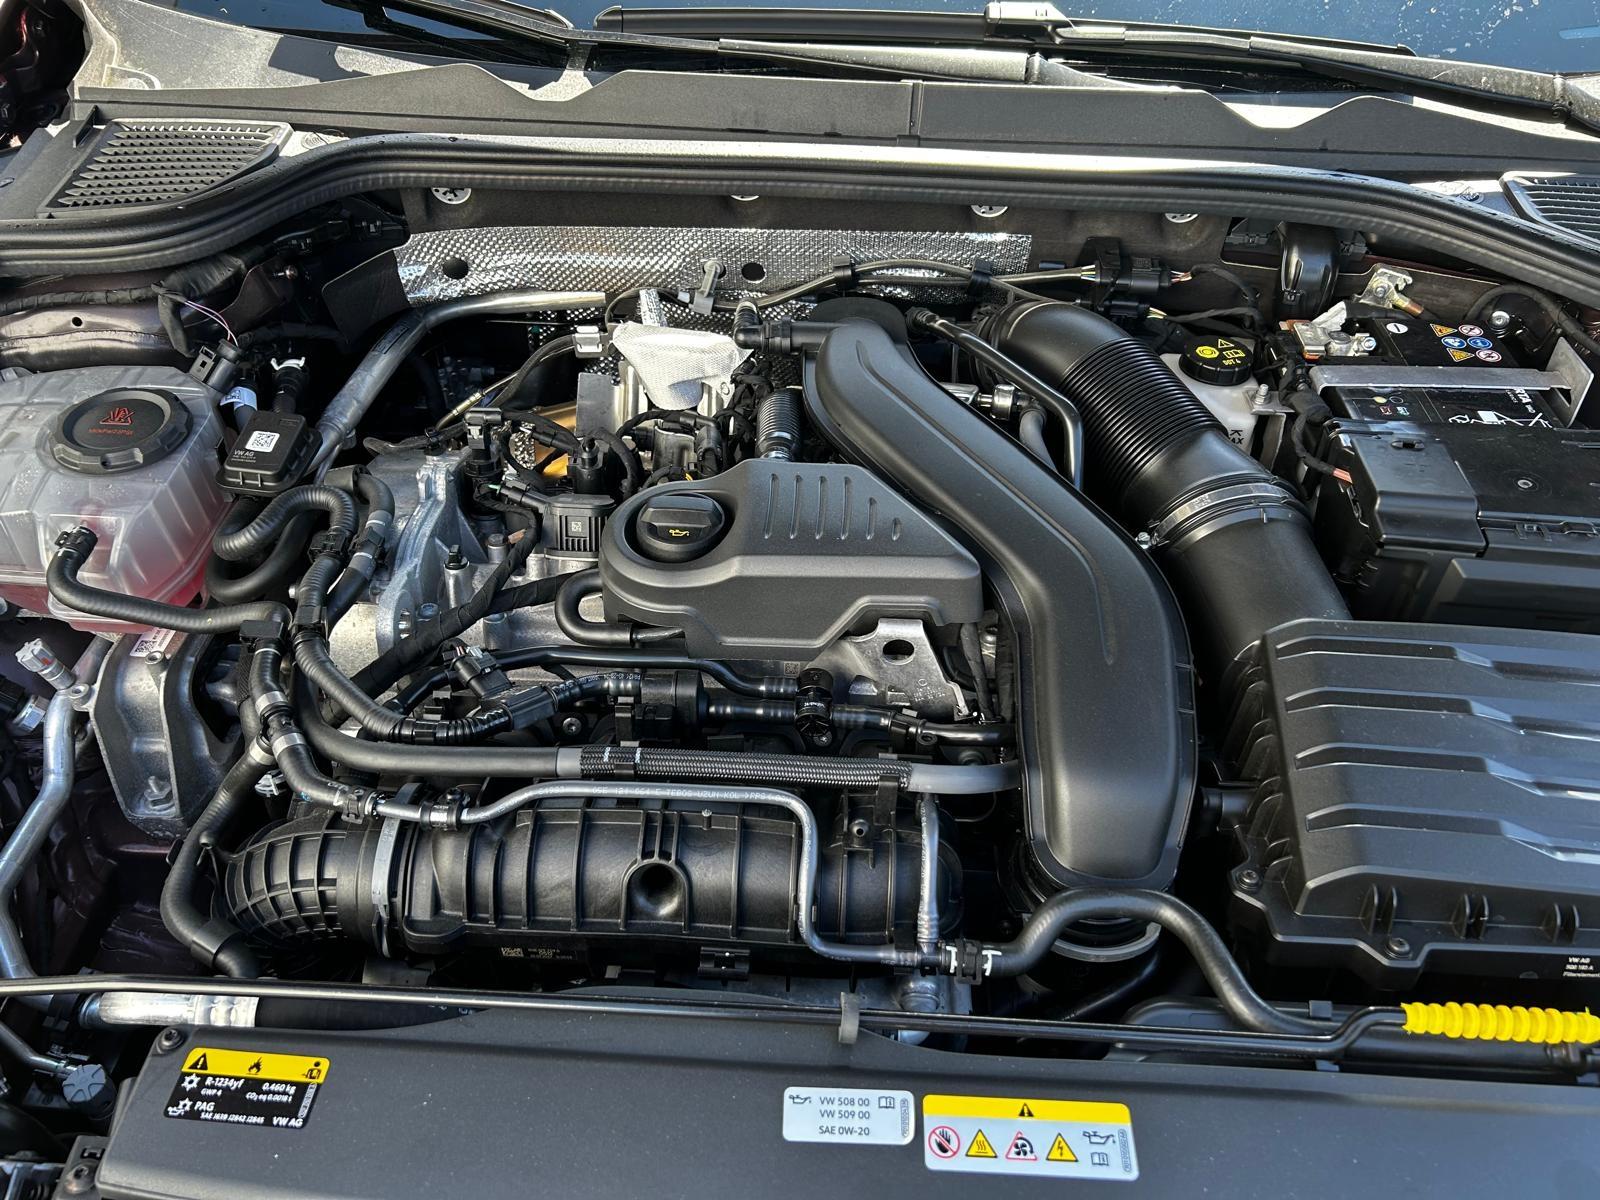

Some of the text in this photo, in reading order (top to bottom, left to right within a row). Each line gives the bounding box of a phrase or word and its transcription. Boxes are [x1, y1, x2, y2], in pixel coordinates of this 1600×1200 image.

[204, 1076, 297, 1095] R-1234yf 0.460 kg
[200, 1088, 217, 1096] GWP
[819, 1097, 870, 1106] VW 508 00
[194, 1102, 215, 1111] PAG
[819, 1110, 870, 1119] VW 509 00
[272, 1116, 289, 1126] VW
[288, 1117, 303, 1127] AG
[819, 1126, 870, 1135] SAE 0W-20
